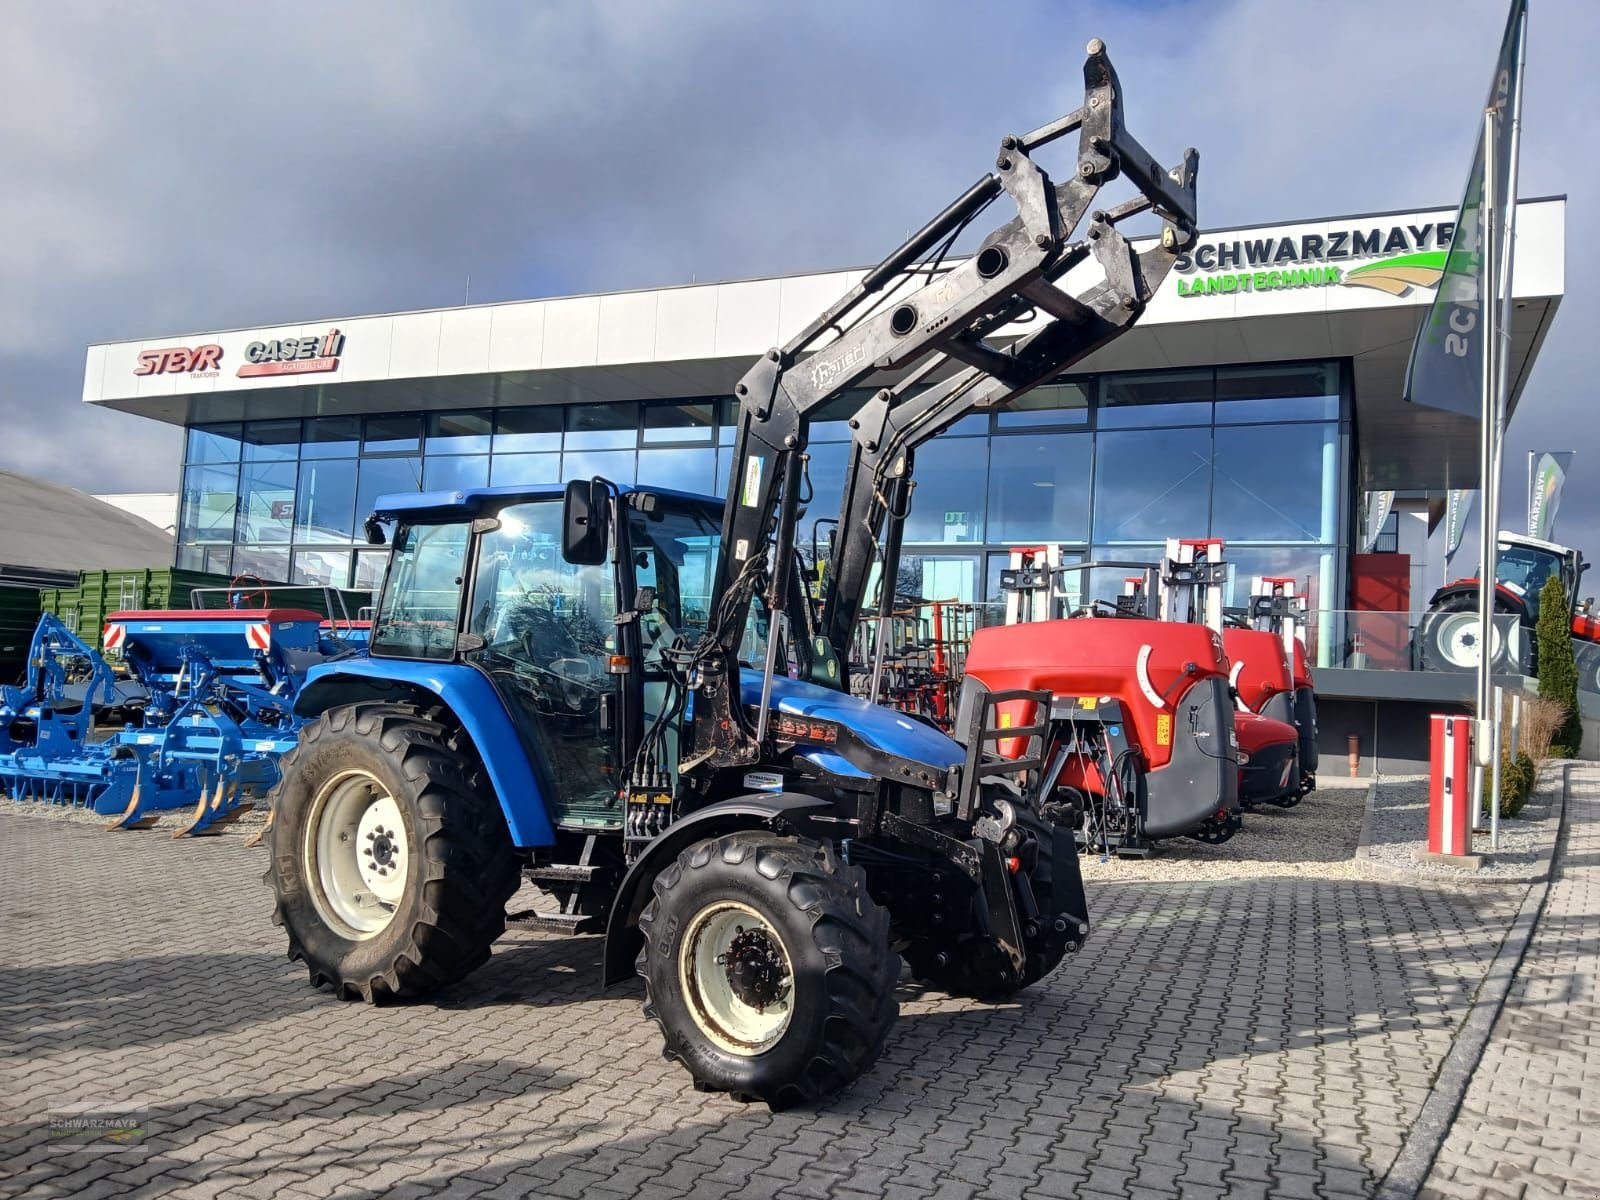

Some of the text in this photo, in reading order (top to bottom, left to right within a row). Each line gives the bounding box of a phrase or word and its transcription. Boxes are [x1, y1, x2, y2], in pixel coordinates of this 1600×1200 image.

[1173, 222, 1457, 272] SCHWARZMAYR
[1177, 266, 1341, 297] LANDTECHNIK
[133, 344, 224, 375] STEYR
[244, 336, 318, 363] CASE
